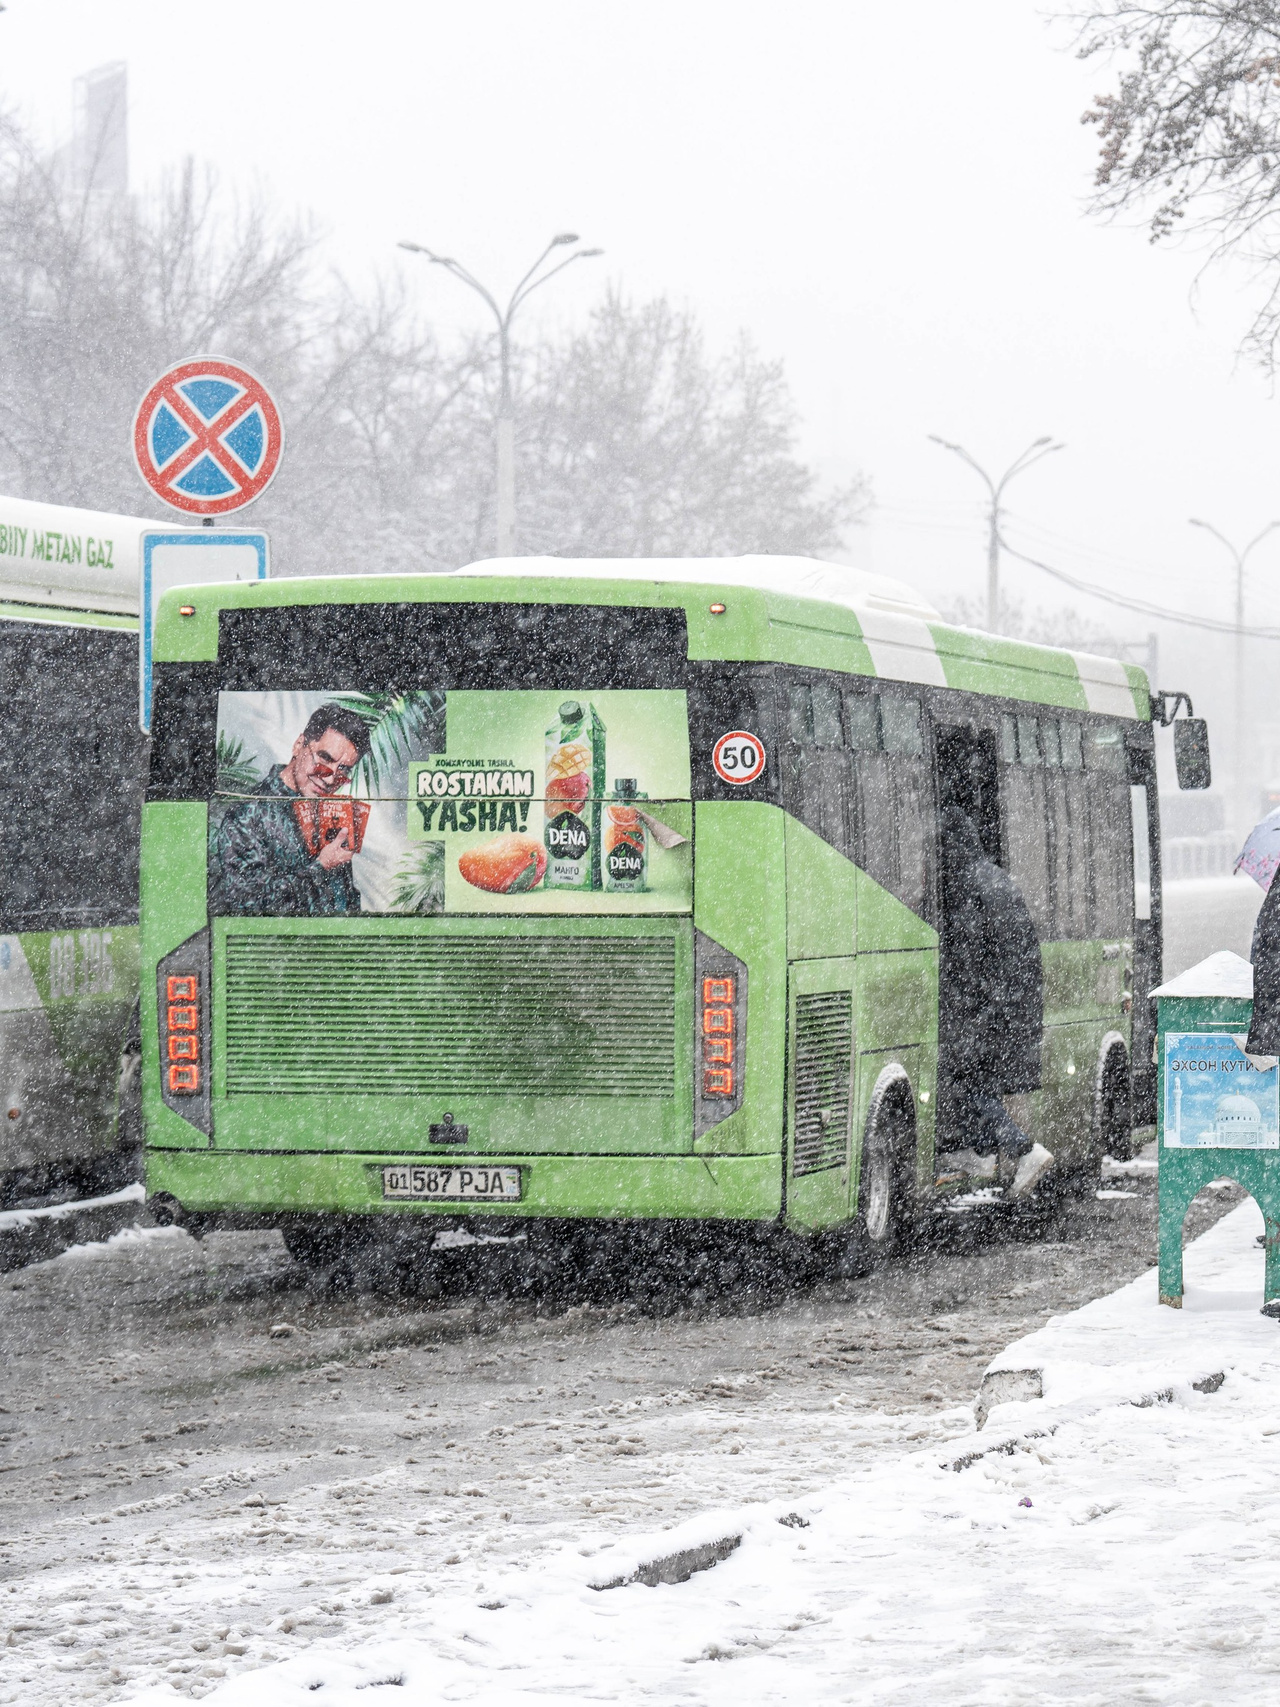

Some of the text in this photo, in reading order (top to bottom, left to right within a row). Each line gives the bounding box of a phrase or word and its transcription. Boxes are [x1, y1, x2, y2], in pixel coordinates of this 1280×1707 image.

[32, 528, 82, 564] METAN
[87, 536, 114, 569] GAZ
[722, 745, 756, 770] 50
[417, 770, 534, 797] ROSTAKAM
[416, 799, 530, 832] YASHA!
[548, 827, 586, 846] DENA
[610, 856, 641, 870] DENA
[1221, 1060, 1274, 1074] ҚУТИ
[389, 1170, 504, 1193] 01 587 PJA
